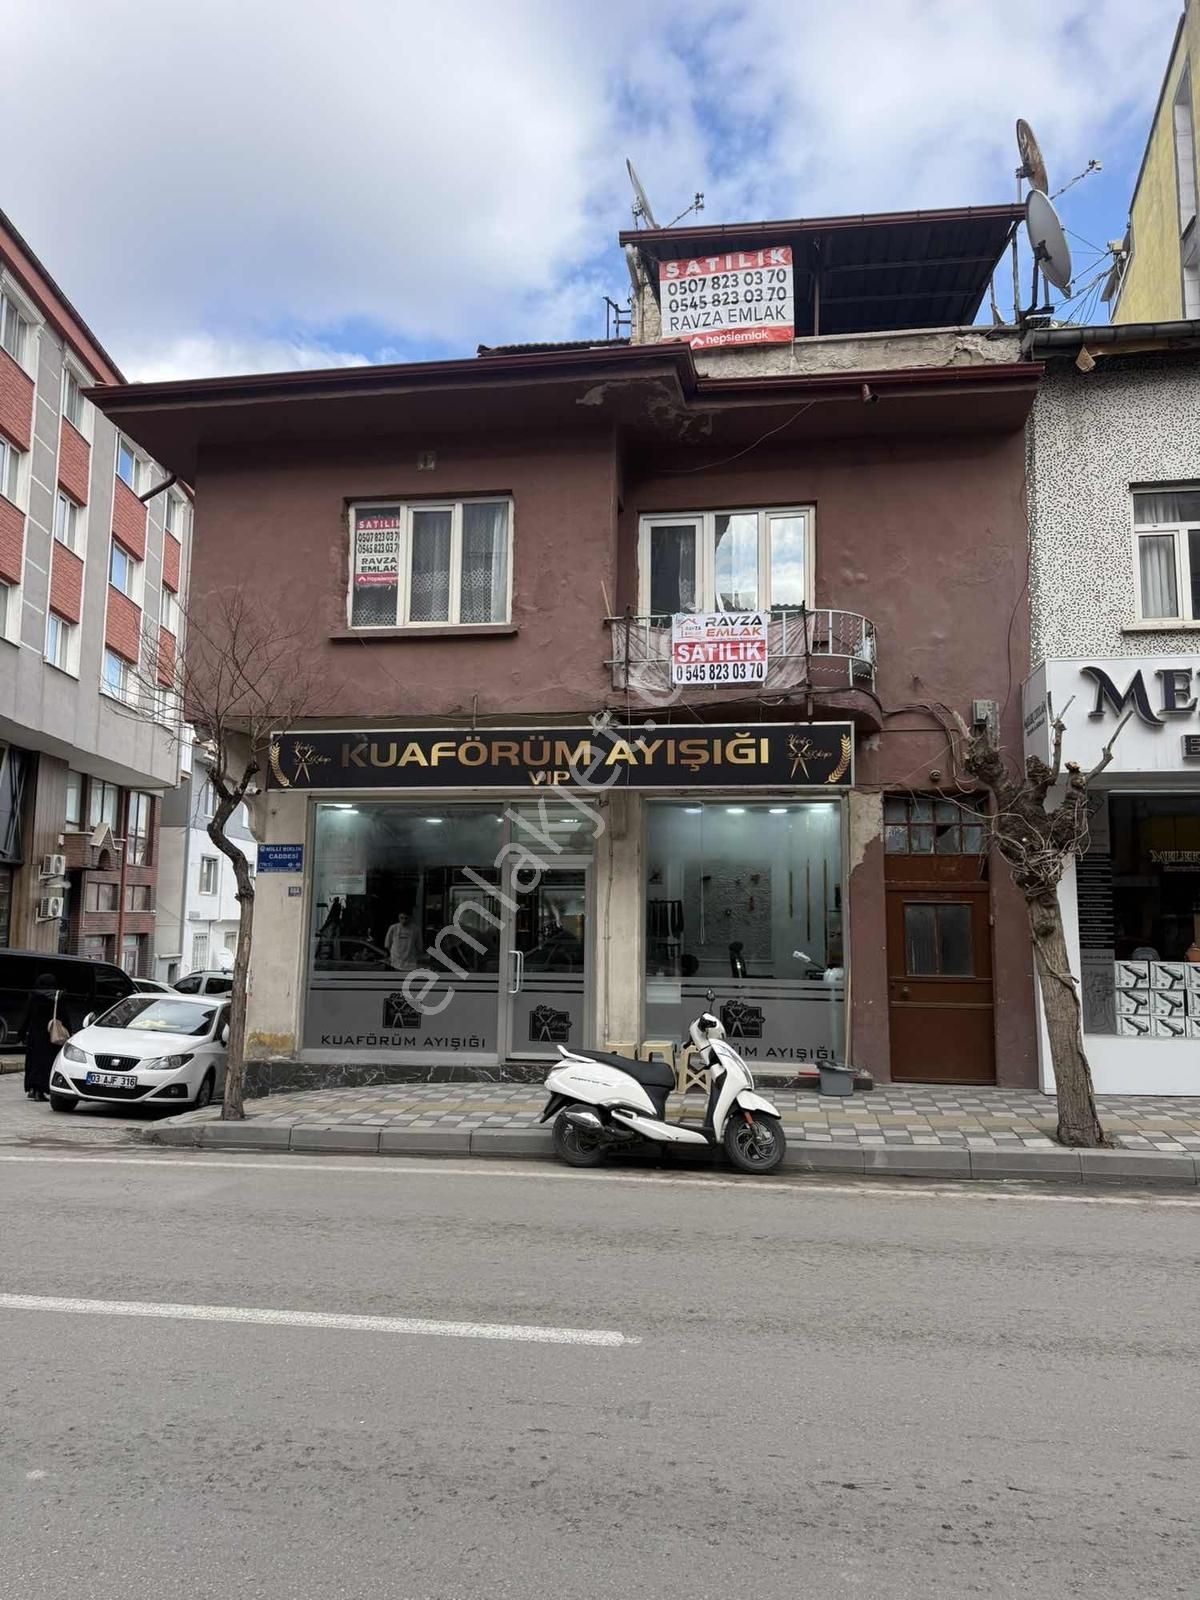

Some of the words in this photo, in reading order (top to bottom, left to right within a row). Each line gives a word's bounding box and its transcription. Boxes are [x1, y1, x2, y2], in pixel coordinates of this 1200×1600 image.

[666, 248, 786, 278] SATILIK
[668, 278, 707, 297] 0507
[711, 274, 739, 290] 823
[744, 271, 763, 287] 03
[767, 268, 787, 284] 70
[669, 295, 707, 313] 0545
[711, 290, 739, 307] 823
[744, 288, 763, 303] 03
[767, 286, 787, 302] 70
[670, 310, 724, 331] RAVZA
[728, 304, 786, 323] EMLAK
[706, 330, 768, 345] hepsiemlak
[357, 532, 373, 542] 0507
[374, 532, 385, 542] 823
[386, 531, 394, 541] 03
[357, 543, 373, 554] 0545
[374, 543, 385, 553] 823
[386, 543, 394, 553] 03
[361, 556, 398, 565] RAVZA
[361, 565, 398, 573] EMLAK
[705, 615, 762, 627] RAVZA
[706, 627, 761, 637] EMLAK
[677, 641, 762, 663] SATILIK
[676, 665, 683, 681] 0
[685, 664, 706, 681] 545
[709, 663, 729, 681] 823
[732, 662, 746, 679] 03
[750, 662, 763, 678] 70
[1080, 665, 1200, 727] ME
[341, 735, 591, 768] KUAFÖRÜM
[605, 732, 769, 772] AYIŞIĞI
[528, 770, 571, 786] VIP
[321, 1033, 417, 1047] KUAFÖRÜM
[423, 1035, 486, 1050] AYIŞIĞI
[766, 1045, 835, 1062] AYIŞIĞI
[91, 1074, 100, 1083] 03
